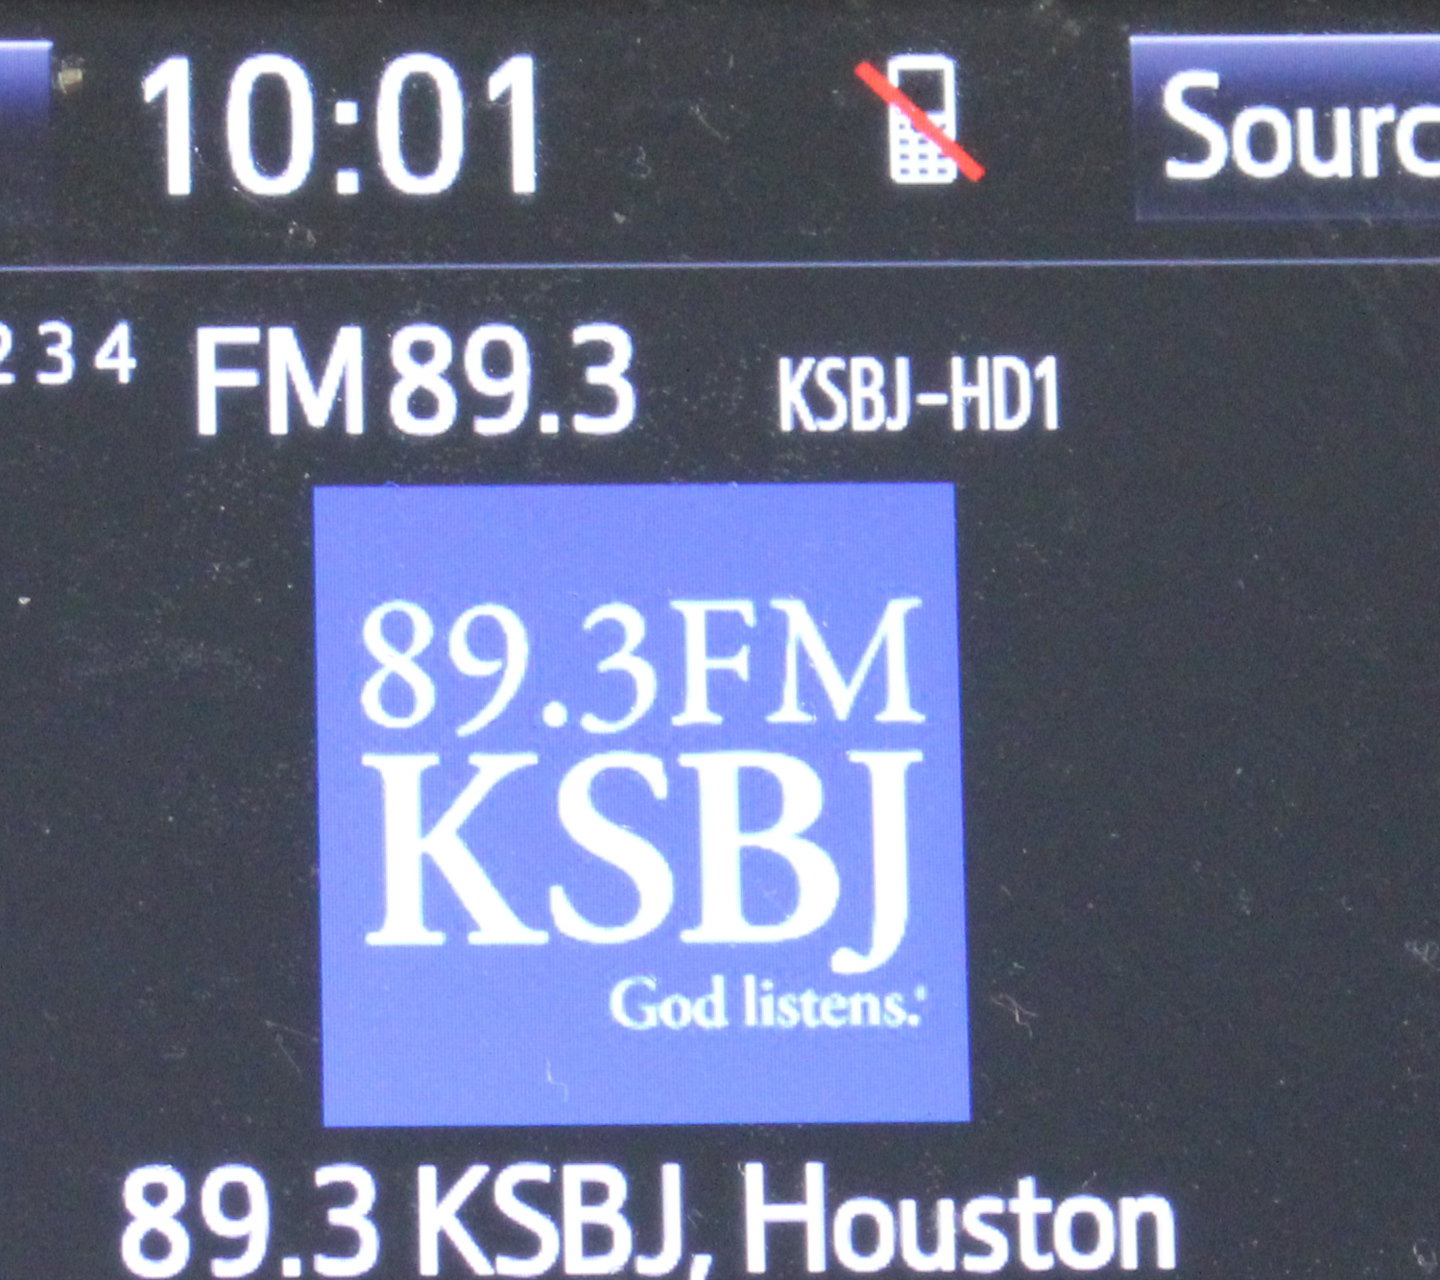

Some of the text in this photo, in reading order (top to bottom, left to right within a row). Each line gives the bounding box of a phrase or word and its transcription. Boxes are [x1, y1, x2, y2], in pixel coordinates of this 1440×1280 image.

[139, 51, 539, 198] 10:01
[359, 597, 926, 738] 89.3FM
[360, 750, 924, 976] KSBJ
[608, 973, 730, 1032] God
[120, 1162, 381, 1280] 89.3
[740, 1160, 1177, 1275] Houston
